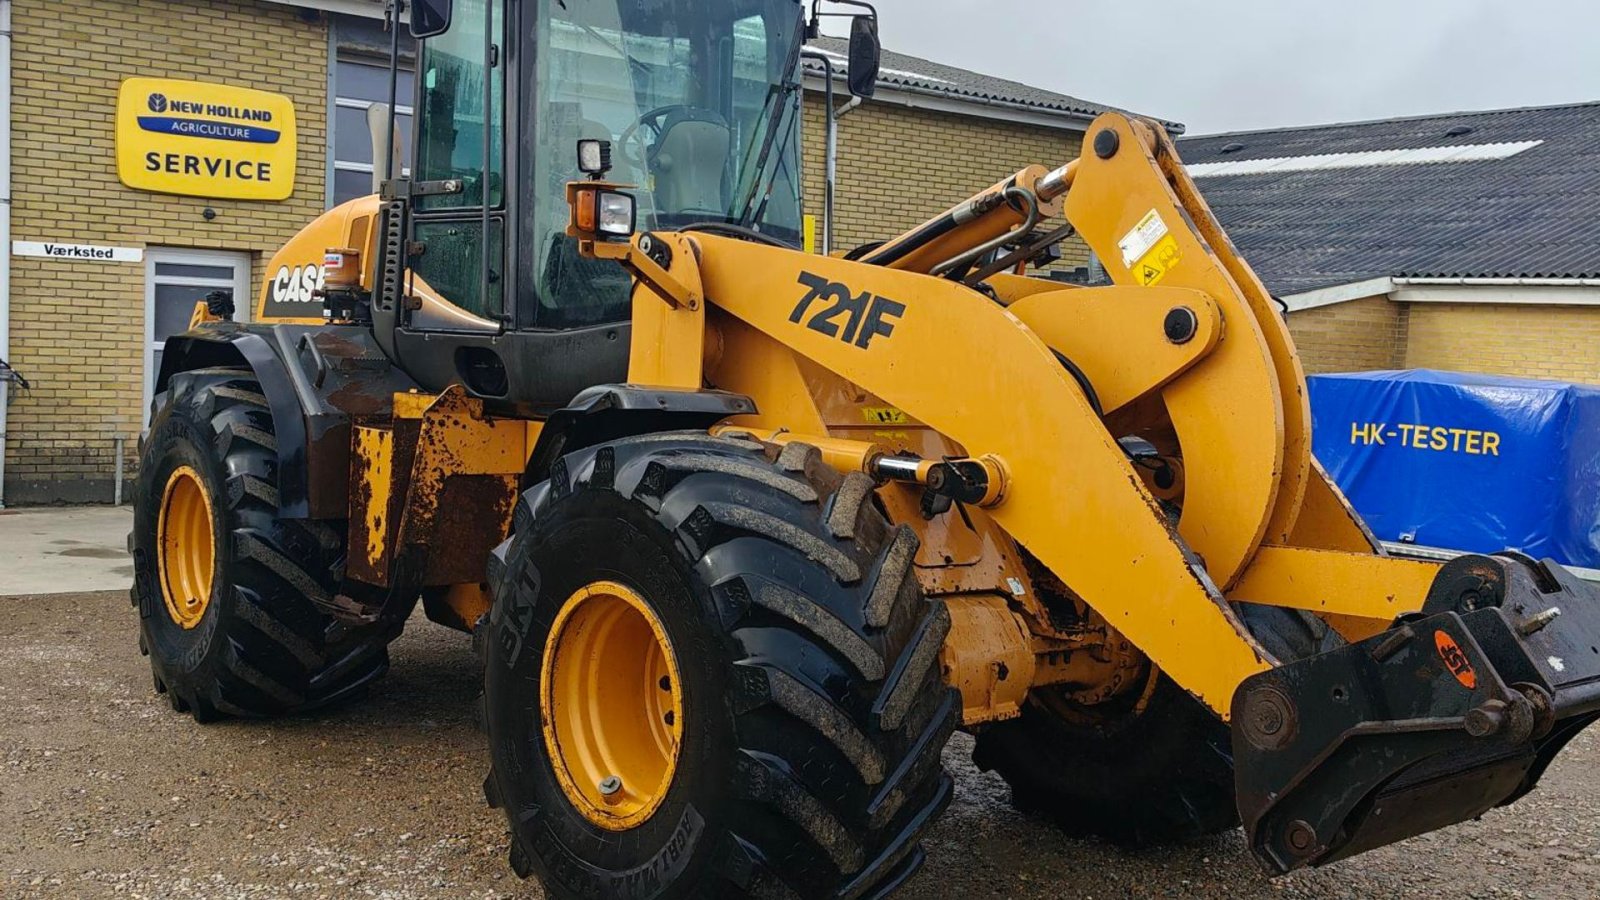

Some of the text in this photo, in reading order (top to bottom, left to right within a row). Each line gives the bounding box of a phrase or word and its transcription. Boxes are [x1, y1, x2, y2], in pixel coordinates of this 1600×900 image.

[170, 100, 272, 122] NEW HOLLAND
[171, 122, 250, 138] AGRICULTURE
[146, 152, 271, 182] SERVICE
[44, 244, 114, 259] Værksted
[788, 270, 907, 350] 721F
[1351, 422, 1501, 456] HK-TESTER
